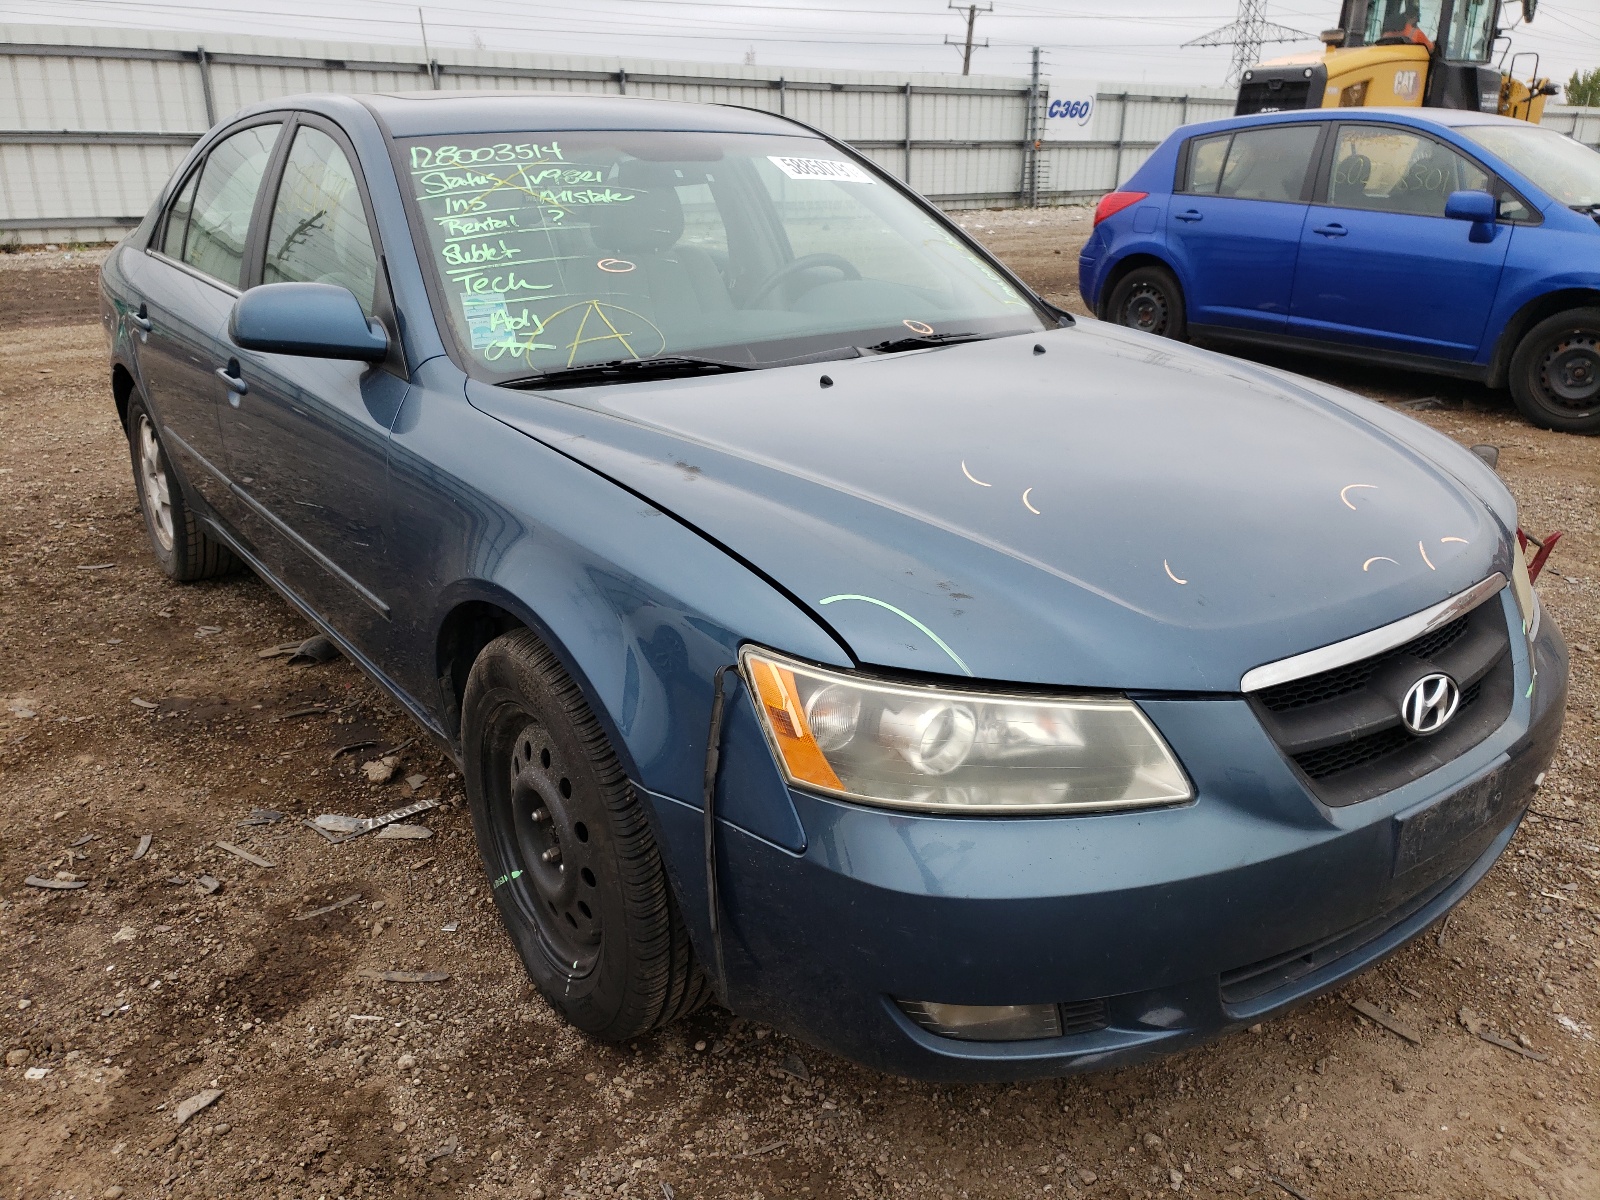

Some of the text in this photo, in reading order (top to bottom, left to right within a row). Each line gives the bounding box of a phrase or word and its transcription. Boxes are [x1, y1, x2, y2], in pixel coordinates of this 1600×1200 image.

[1394, 70, 1416, 95] CAT
[1048, 99, 1090, 119] C360
[445, 197, 488, 214] Ins
[439, 214, 520, 236] Rental
[452, 272, 554, 295] Tech
